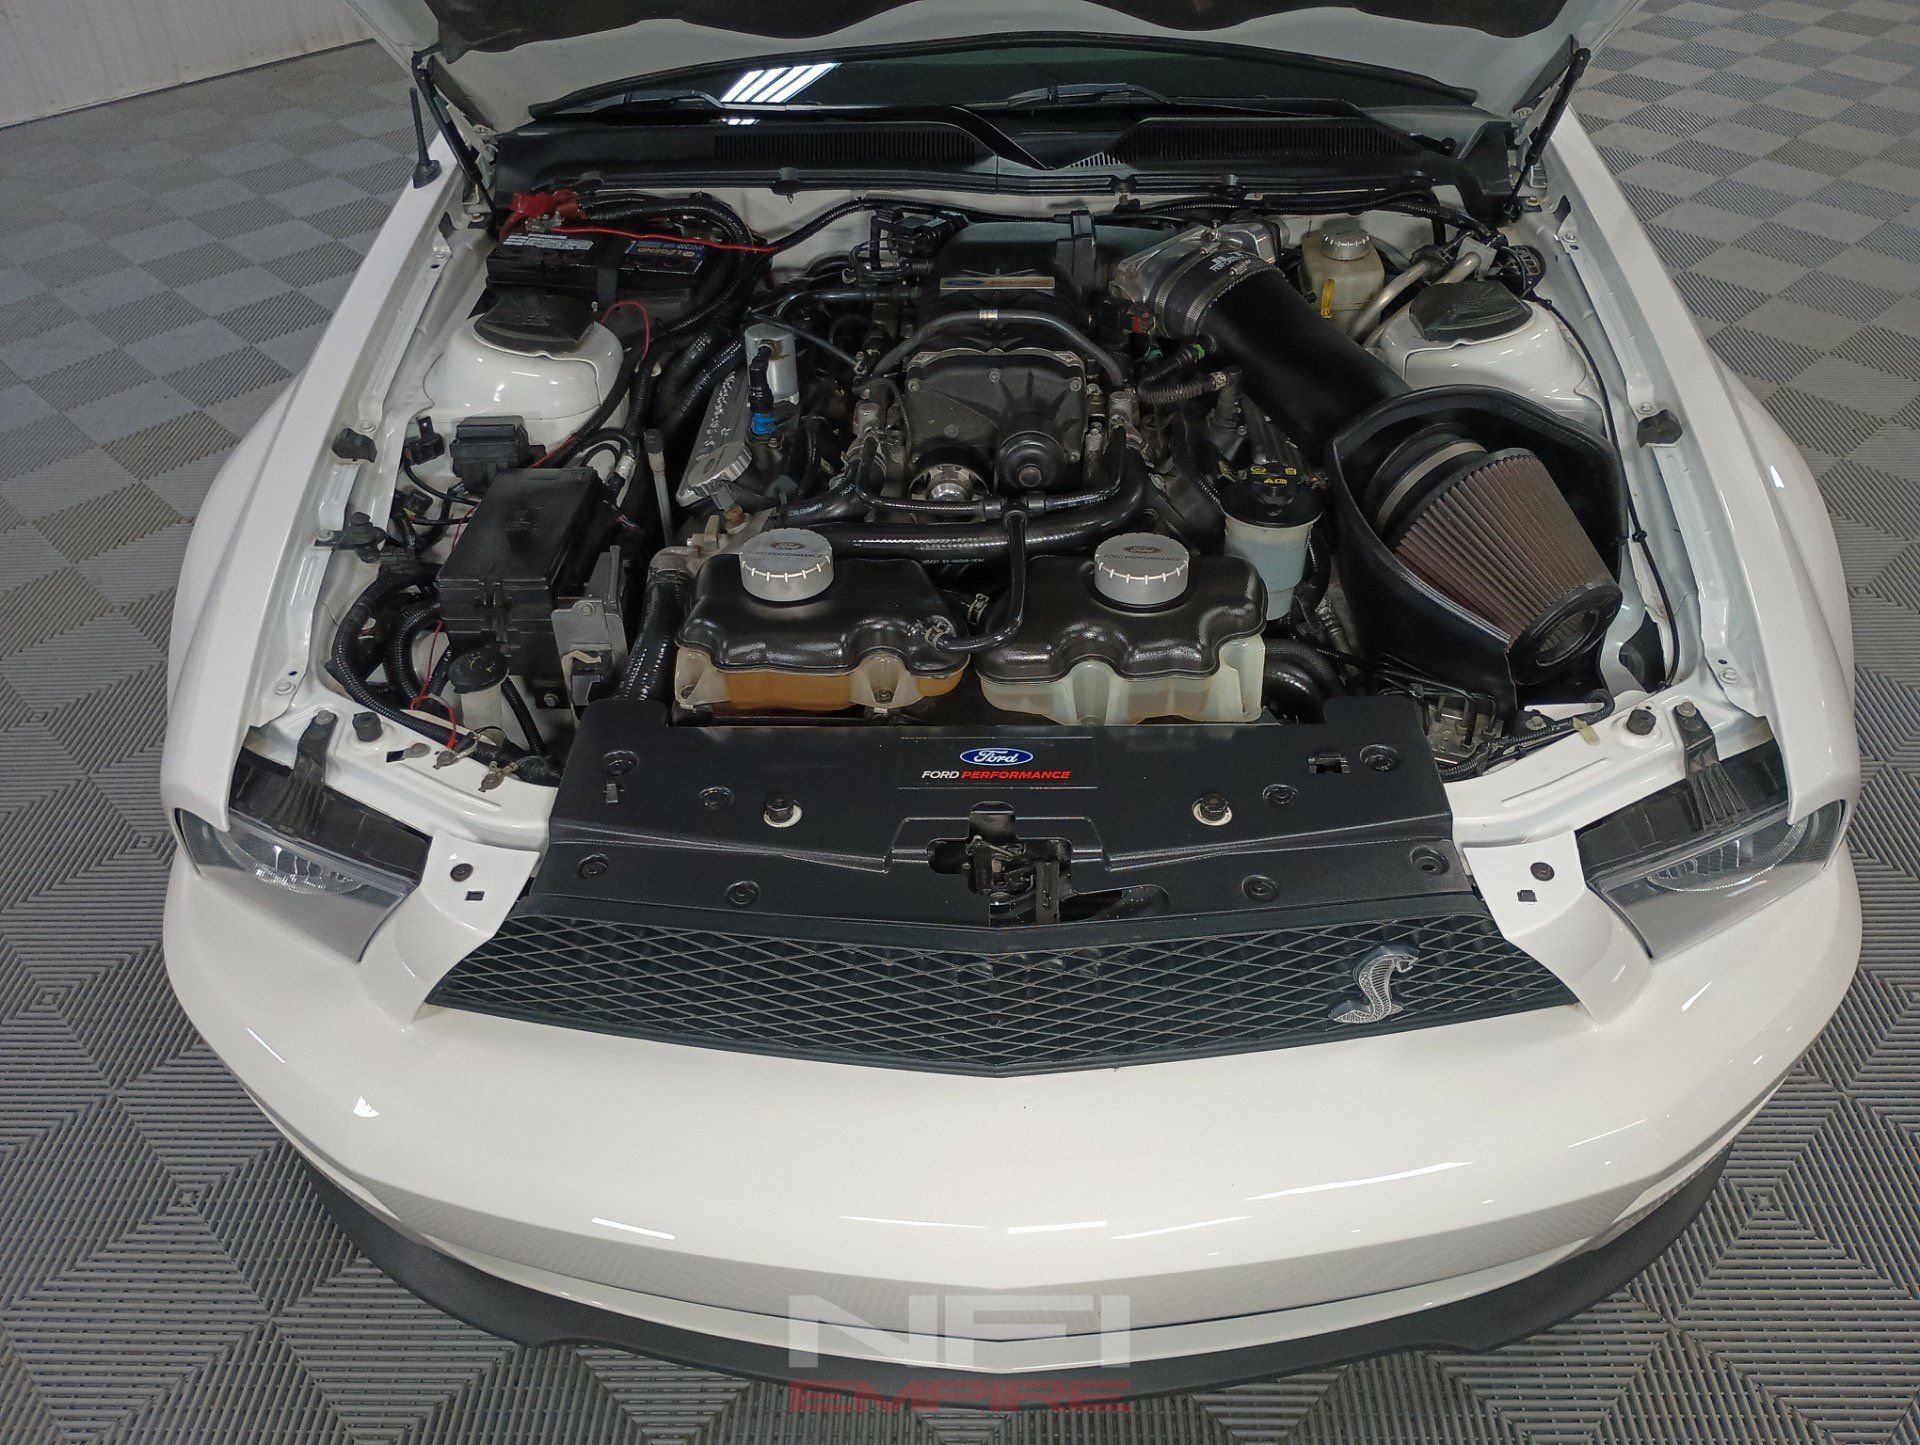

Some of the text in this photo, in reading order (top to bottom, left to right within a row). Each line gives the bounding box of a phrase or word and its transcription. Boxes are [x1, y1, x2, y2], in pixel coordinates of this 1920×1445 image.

[973, 749, 1019, 763] Ford
[921, 770, 1071, 779] FORD PERFORMANCE
